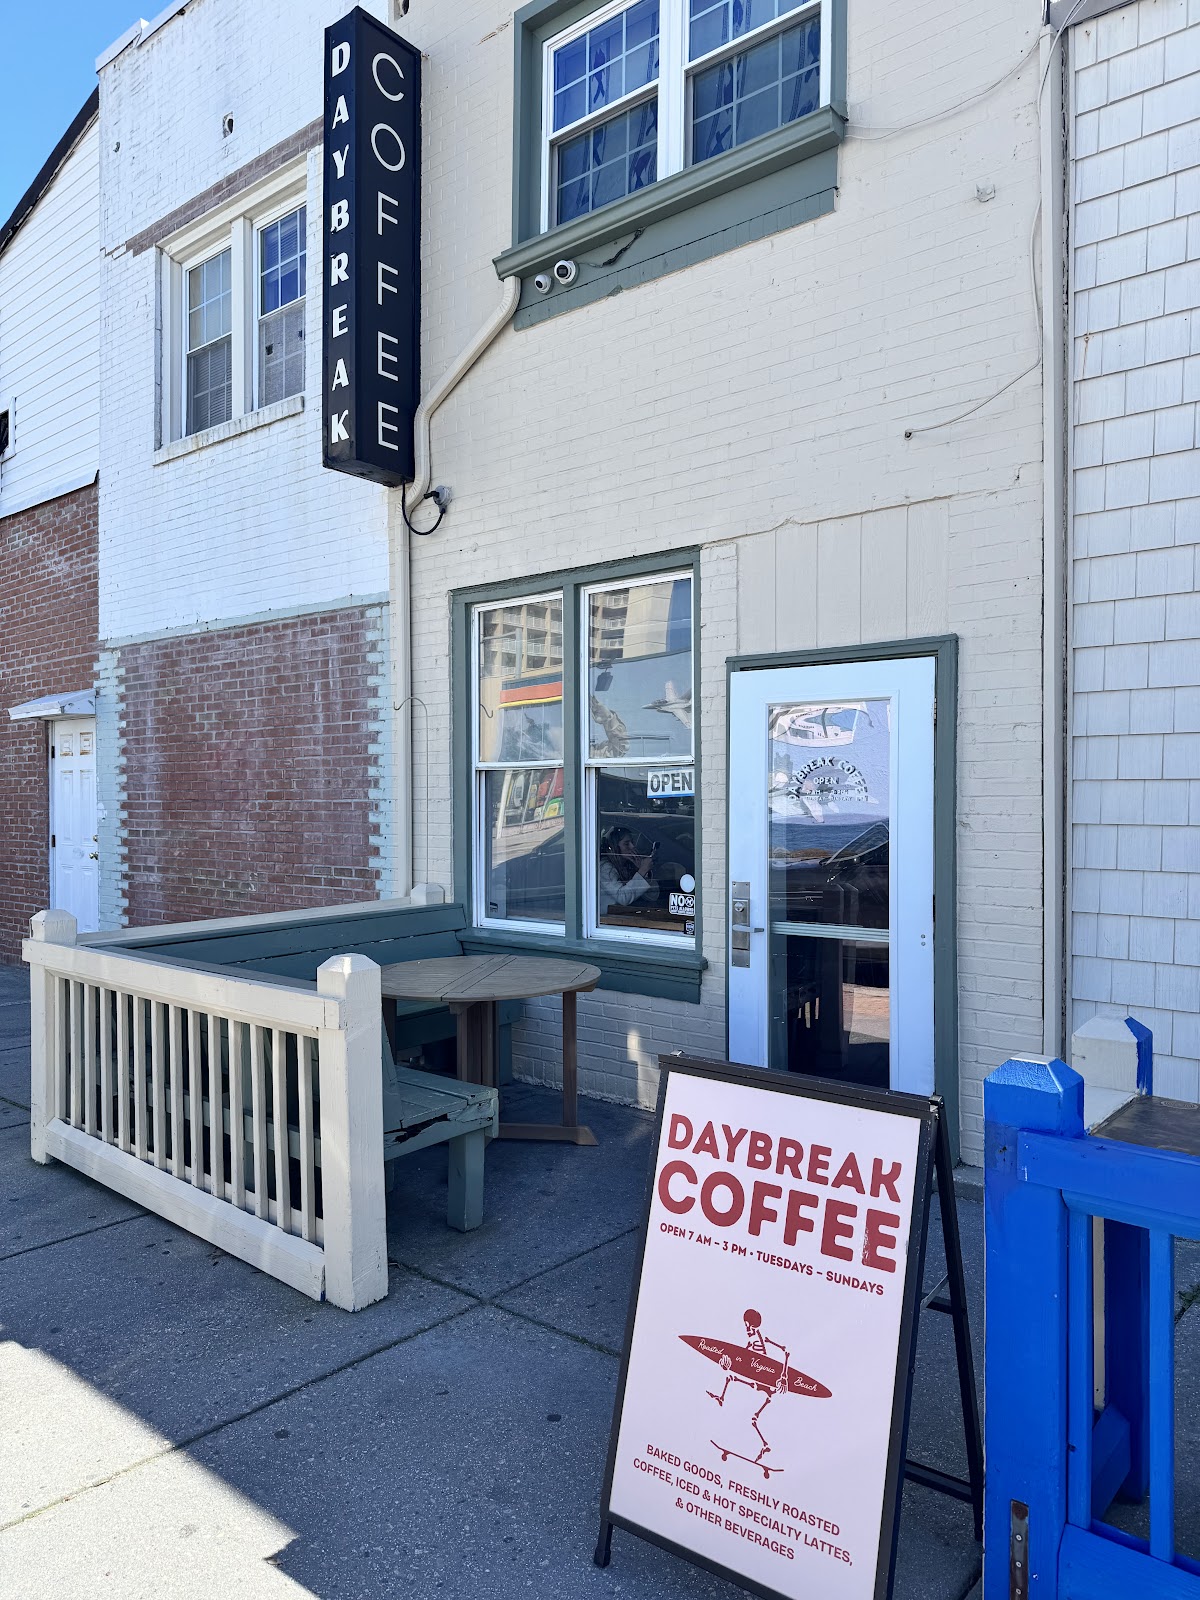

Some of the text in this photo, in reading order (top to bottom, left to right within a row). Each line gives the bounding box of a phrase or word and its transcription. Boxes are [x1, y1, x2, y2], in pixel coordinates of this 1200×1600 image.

[331, 41, 350, 444] DAYBREAK
[371, 52, 406, 451] COFFEE
[650, 772, 693, 793] OPEN
[787, 757, 834, 801] DAYBREAK
[671, 894, 685, 906] NO
[668, 1113, 902, 1203] DAYBREAK
[658, 1160, 901, 1273] COFFEE
[660, 1222, 686, 1238] OPEN
[688, 1231, 694, 1240] 7
[696, 1233, 712, 1247] AM
[722, 1240, 729, 1252] 3
[731, 1243, 747, 1257] PM
[756, 1250, 813, 1276] TUESDAYS
[826, 1271, 884, 1296] SUNDAYS
[698, 1339, 724, 1355] Roasted
[750, 1358, 776, 1374] Virginia
[793, 1376, 818, 1392] Beach
[633, 1458, 853, 1566] COFFEE, ICED & HOT SPECIALTY LATTES,
[646, 1444, 840, 1536] BAKED GOODS, FRESHLY ROASTED
[675, 1497, 795, 1560] & OTHER BEVERAGES
